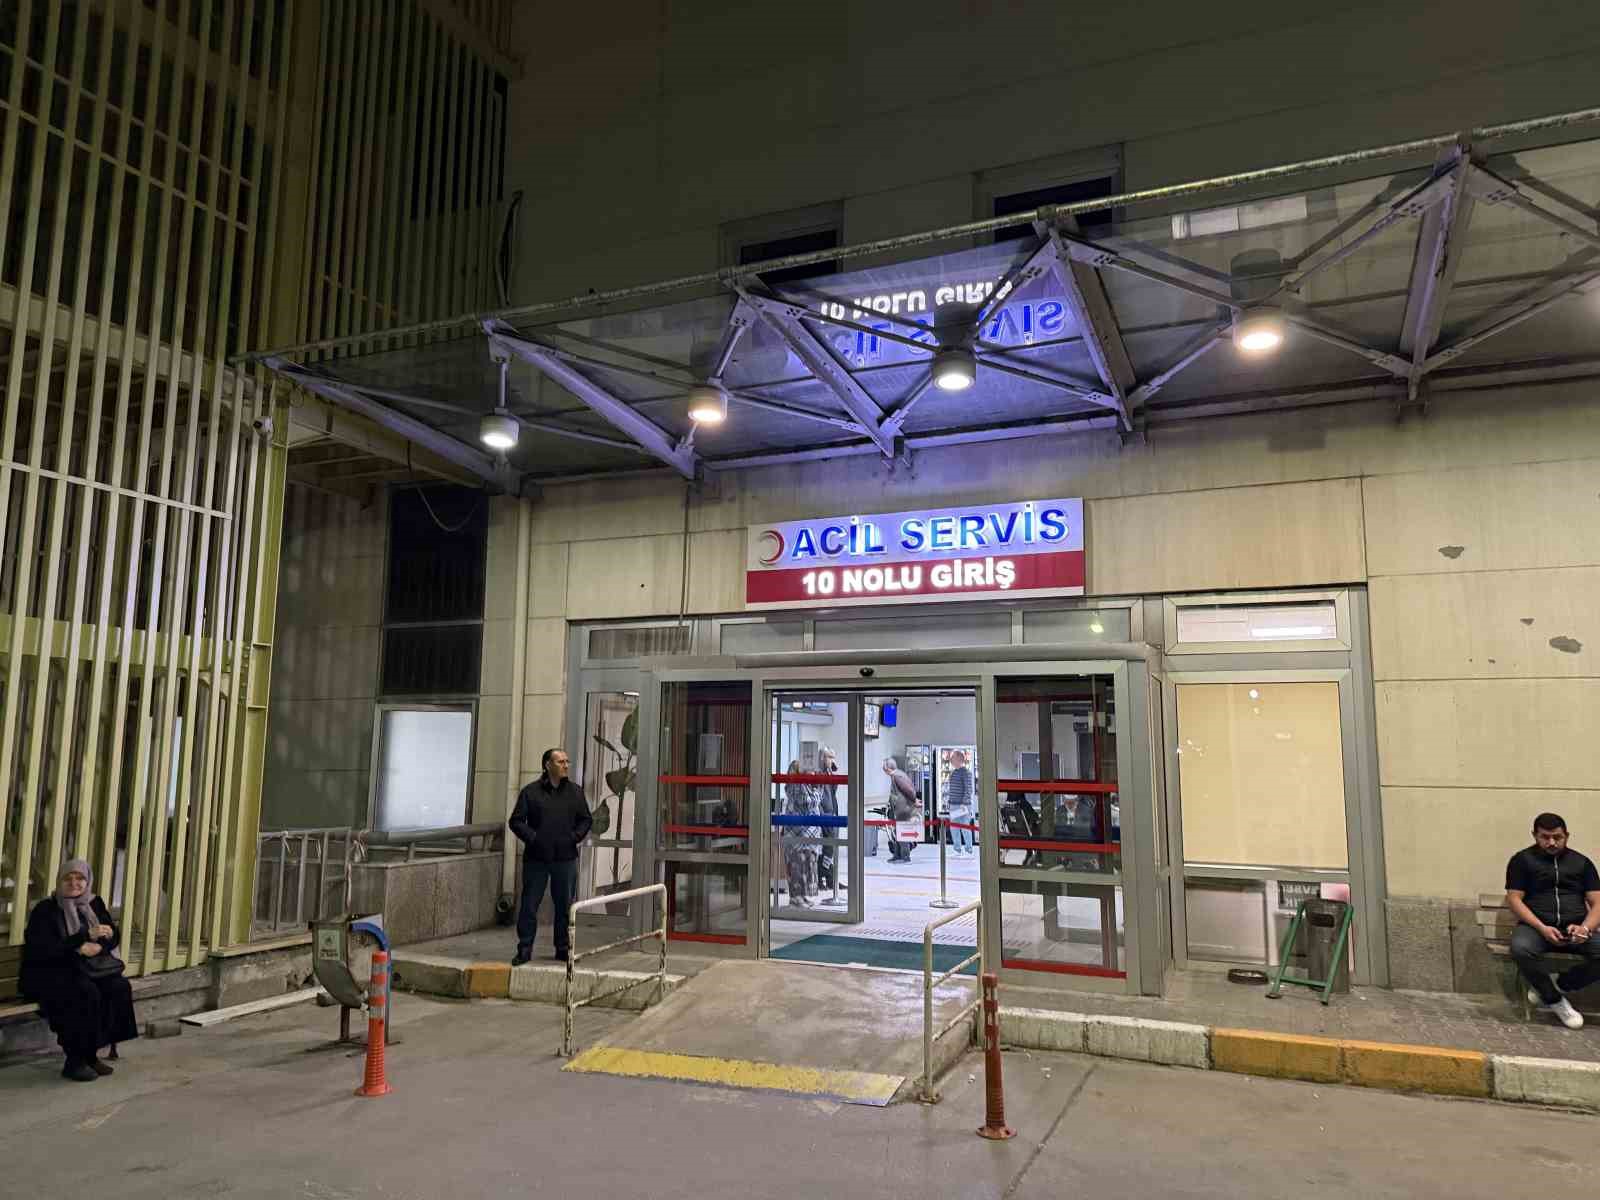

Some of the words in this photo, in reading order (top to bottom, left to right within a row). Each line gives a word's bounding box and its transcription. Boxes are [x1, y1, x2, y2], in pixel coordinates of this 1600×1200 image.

[792, 515, 886, 559] ACİL
[901, 502, 1068, 551] SERVİS
[802, 570, 835, 595] 10
[842, 566, 922, 592] NOLU
[930, 557, 1016, 590] GİRİŞ
